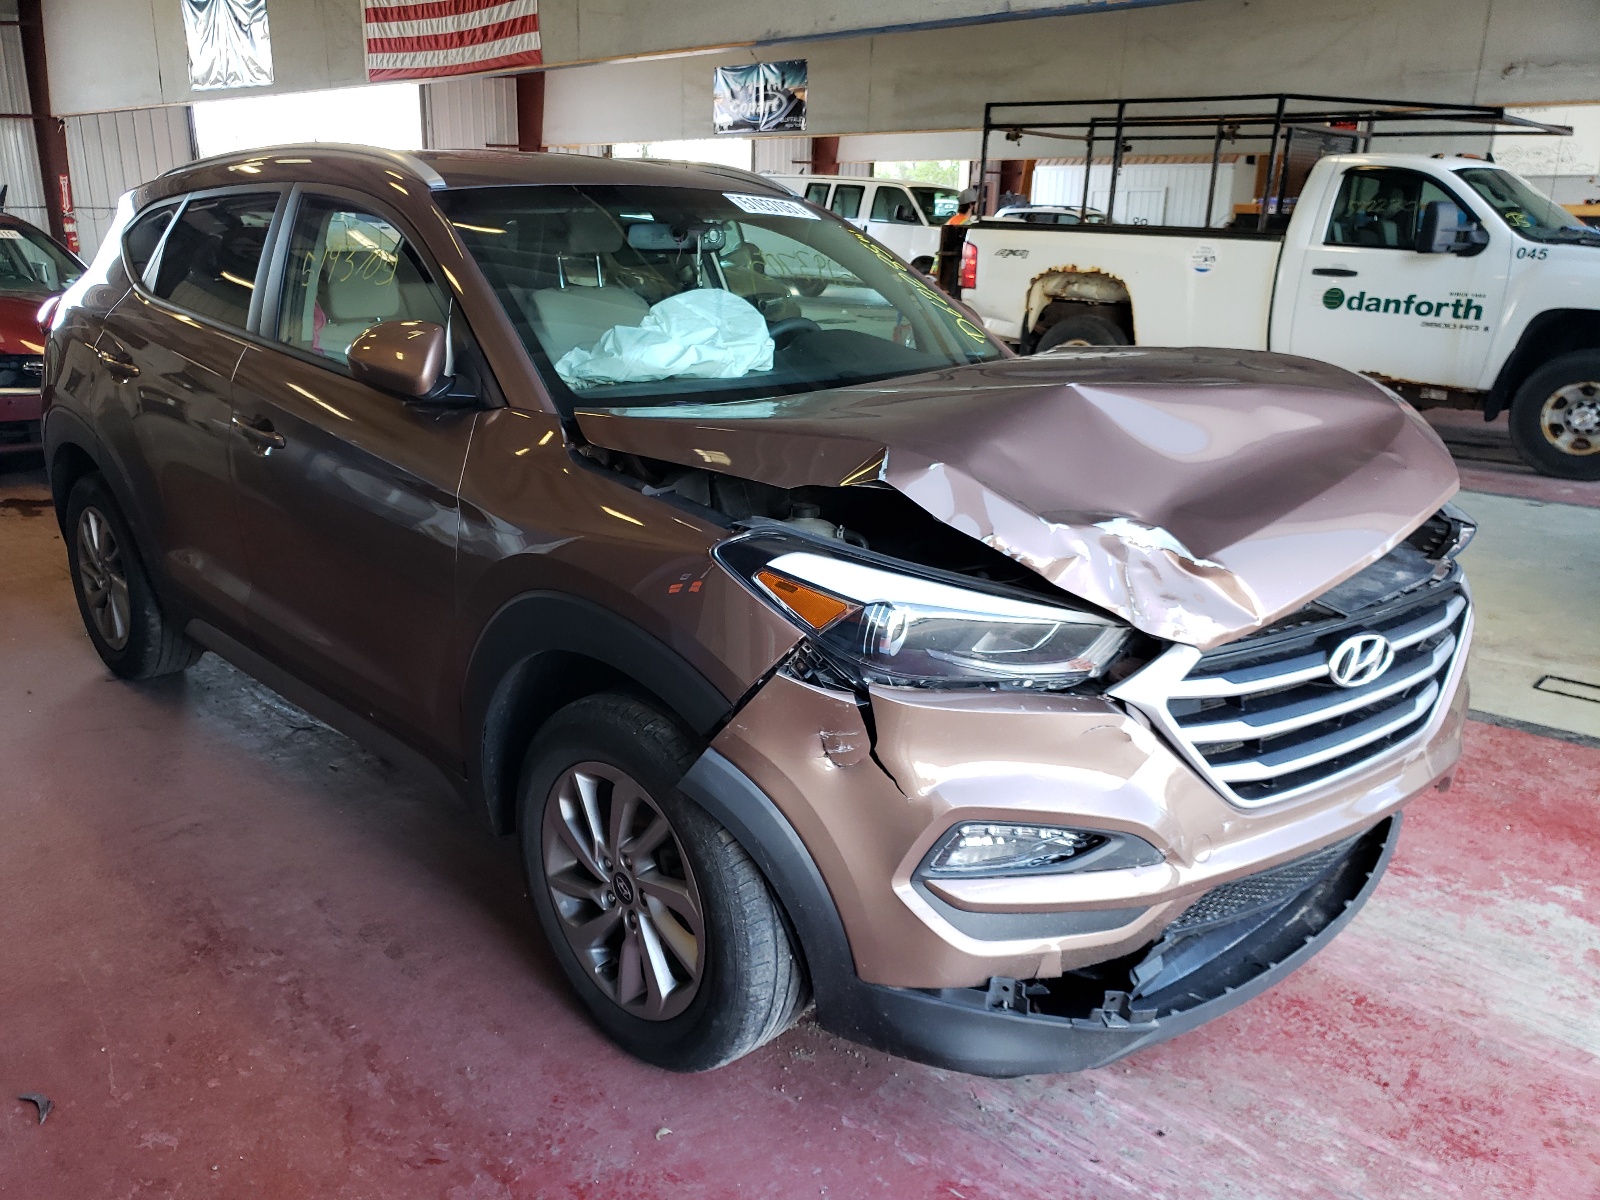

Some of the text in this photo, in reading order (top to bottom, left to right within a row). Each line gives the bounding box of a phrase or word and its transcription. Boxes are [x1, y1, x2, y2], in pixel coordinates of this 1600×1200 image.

[730, 96, 779, 117] Copart
[1516, 247, 1548, 260] 045
[1346, 291, 1484, 320] danforth
